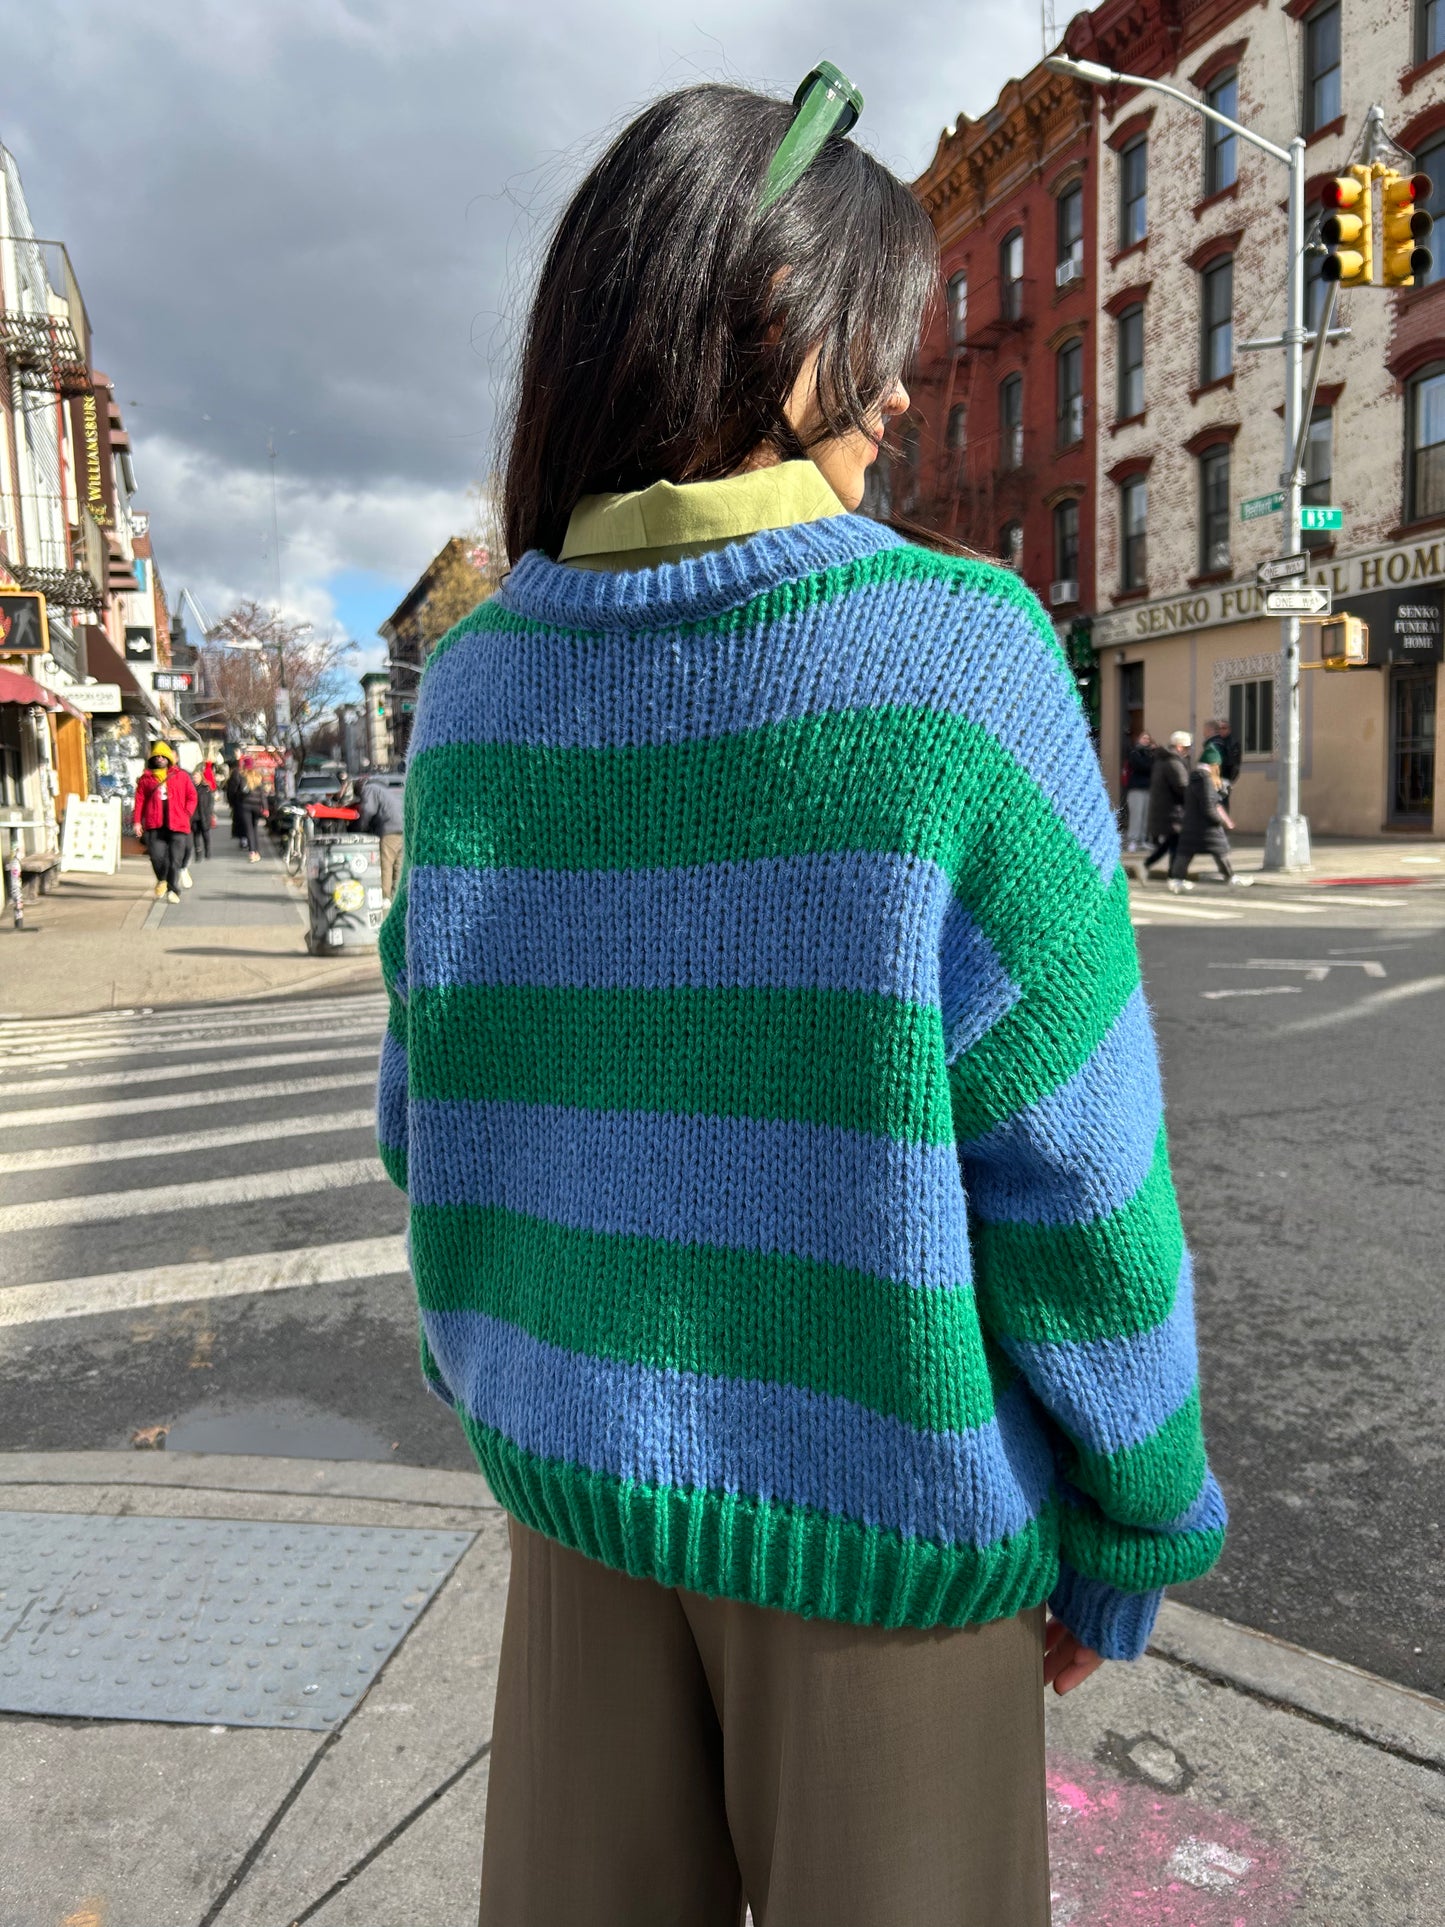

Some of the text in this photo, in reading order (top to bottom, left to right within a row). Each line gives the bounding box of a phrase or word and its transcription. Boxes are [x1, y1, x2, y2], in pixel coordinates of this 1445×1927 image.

[1307, 511, 1315, 527] N
[1317, 511, 1325, 527] 5
[1264, 561, 1302, 577] ONE WAY
[1136, 542, 1445, 635] SENKO FUNAL HOM
[1275, 597, 1319, 607] ONE WAY
[1398, 605, 1439, 619] SENKO
[1394, 620, 1440, 634] FUNERAL
[1403, 635, 1433, 649] HOME
